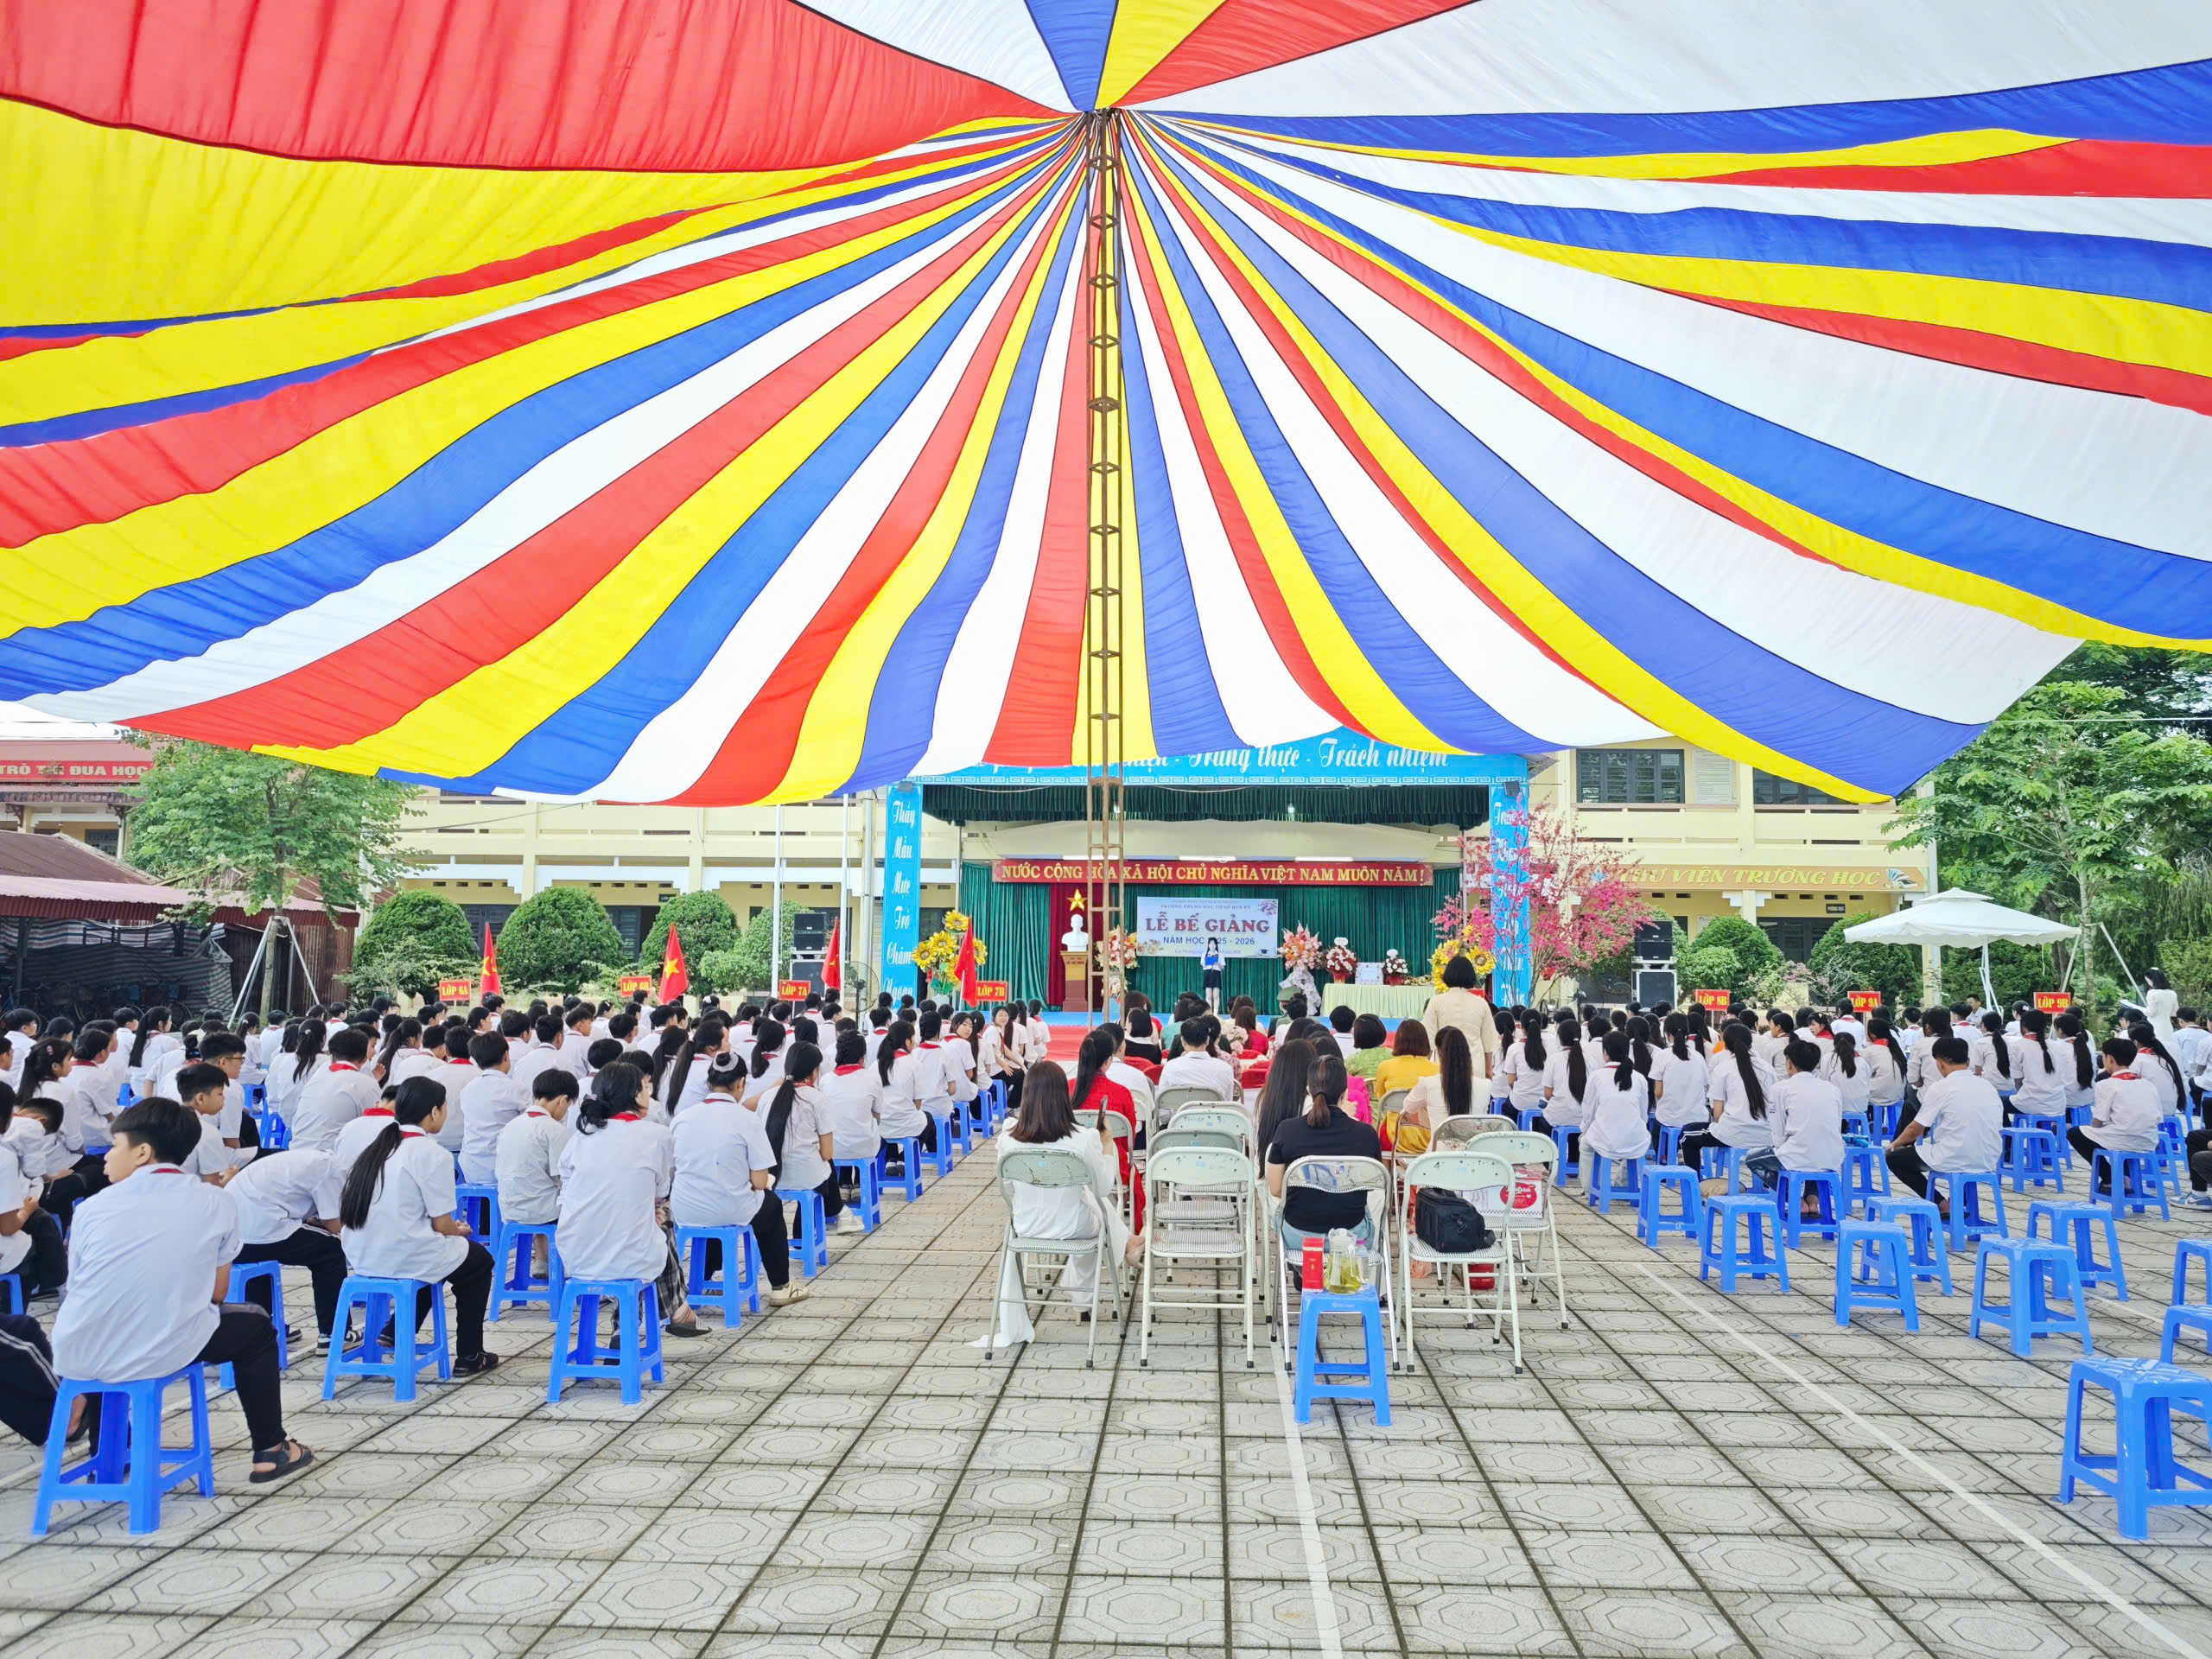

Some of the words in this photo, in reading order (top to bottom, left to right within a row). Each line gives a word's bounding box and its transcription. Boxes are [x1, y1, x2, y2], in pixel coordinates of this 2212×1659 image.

[1319, 738, 1381, 767] Trách
[69, 766, 107, 776] ĐUA
[112, 766, 148, 778] HỌC
[1002, 862, 1040, 879] NƯỚC
[1044, 863, 1083, 881] CỘNG
[1122, 863, 1143, 880] XÃ
[1147, 863, 1173, 882] HỘI
[1176, 862, 1207, 880] CHỦ
[1211, 864, 1259, 880] NGHĨA
[1261, 865, 1296, 883] VIỆT
[1300, 868, 1334, 881] NAM
[1338, 866, 1379, 881] MUÔN
[1672, 866, 1729, 887] VIỆN
[1732, 868, 1826, 886] TRƯỜNG
[1831, 870, 1882, 889] HỌC
[1146, 911, 1168, 931] LỄ
[1175, 912, 1199, 931] BẾ
[1205, 914, 1270, 933] GIẢNG
[1163, 936, 1183, 944] NĂM
[1185, 937, 1205, 945] HỌC
[442, 984, 456, 995] LỚP
[459, 986, 468, 995] 6A
[623, 980, 638, 992] LỚP
[781, 983, 796, 995] LỚP
[798, 986, 808, 995] 7A
[977, 984, 993, 995] LỚP
[995, 986, 1005, 996] 7B
[1699, 993, 1714, 1005] LỚP
[2037, 995, 2055, 1007] LỚP
[2057, 998, 2068, 1007] 9B
